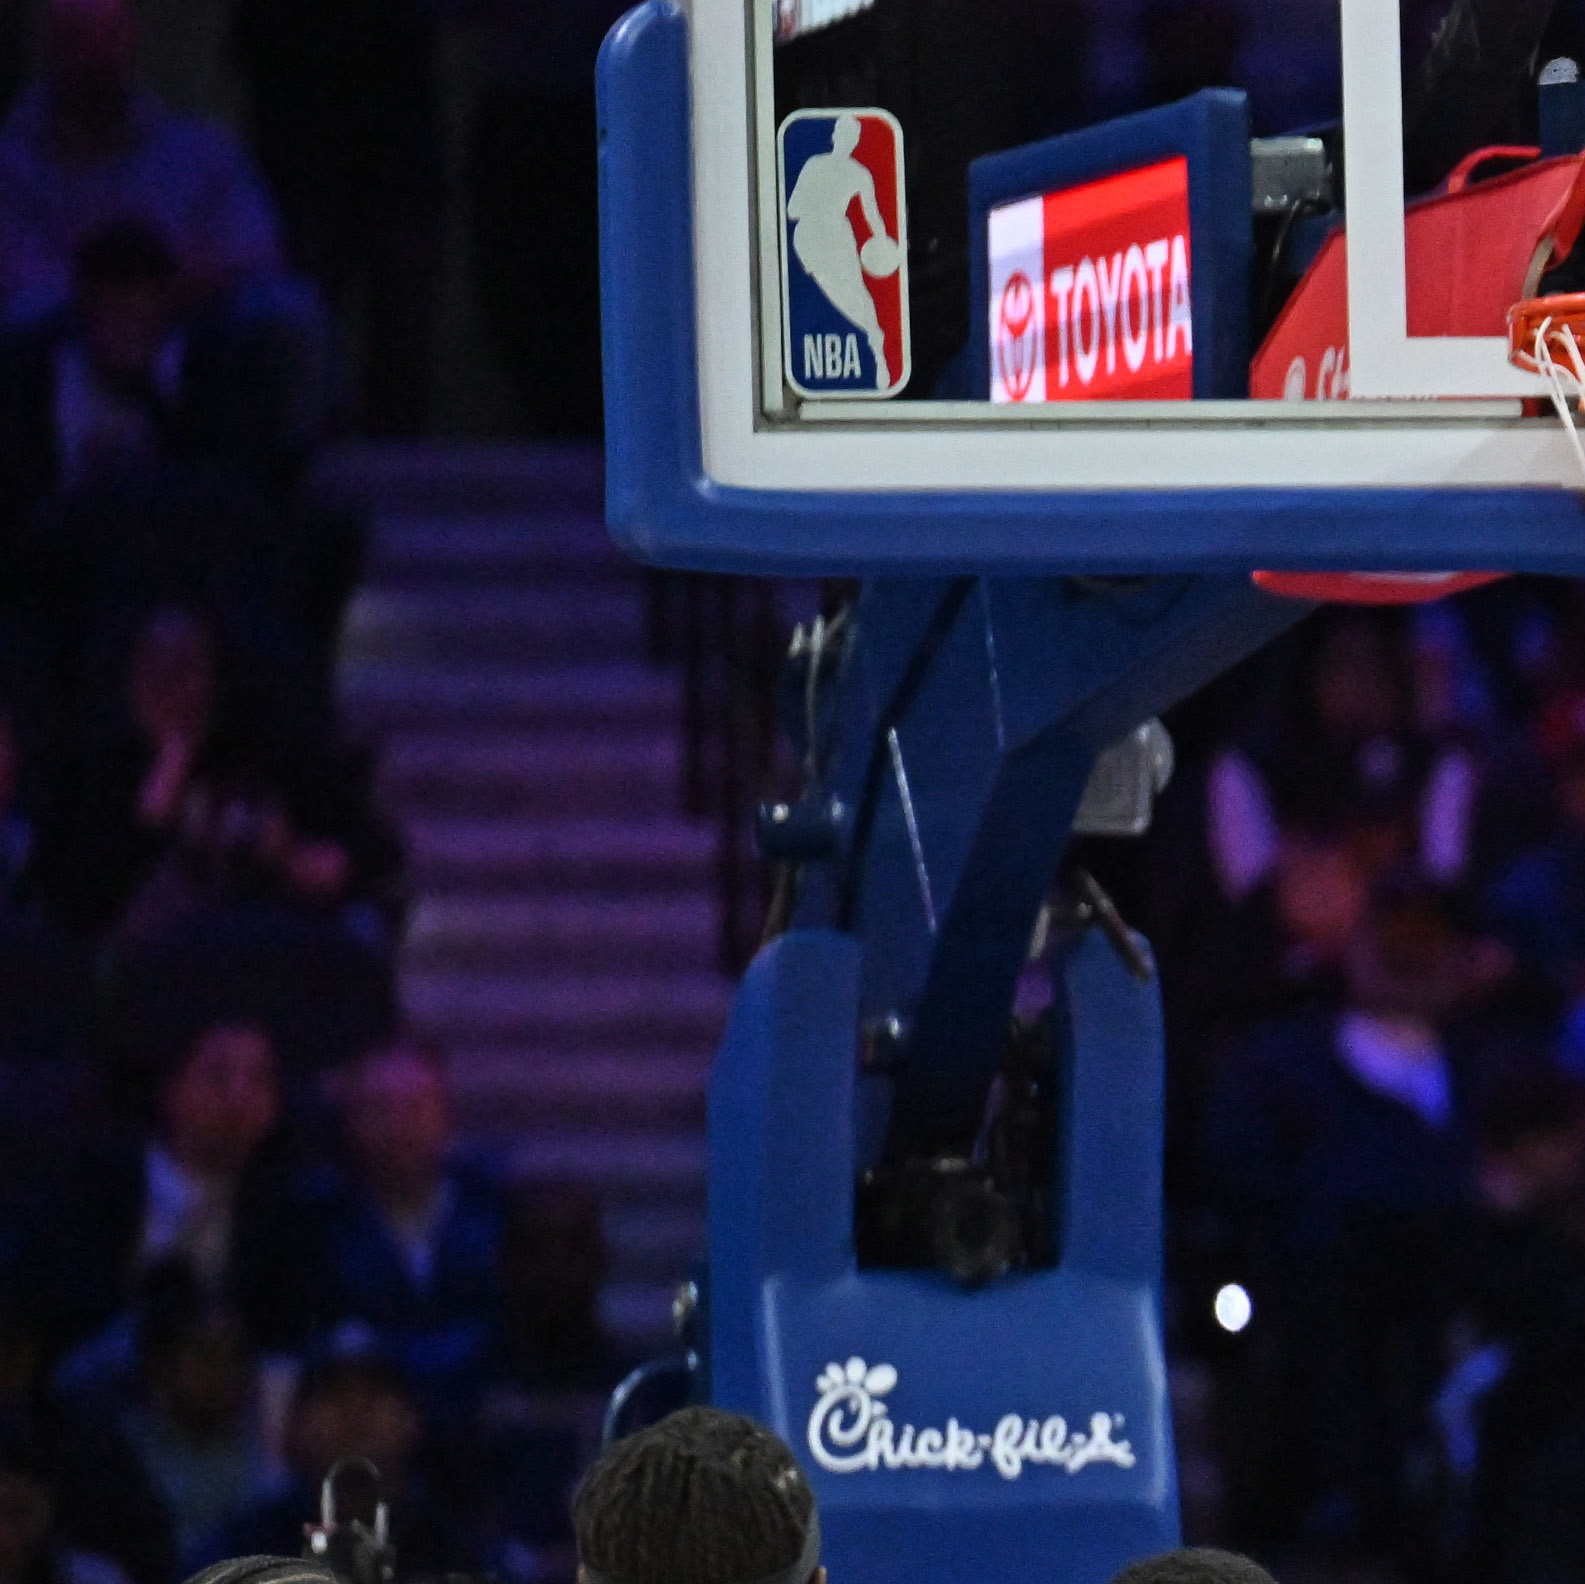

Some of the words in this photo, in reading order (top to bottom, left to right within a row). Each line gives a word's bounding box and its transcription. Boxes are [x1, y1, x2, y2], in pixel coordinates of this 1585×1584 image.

[803, 333, 862, 379] NBA
[1051, 235, 1192, 388] TOYOTA
[807, 1357, 1137, 1480] Chick-fil-A
